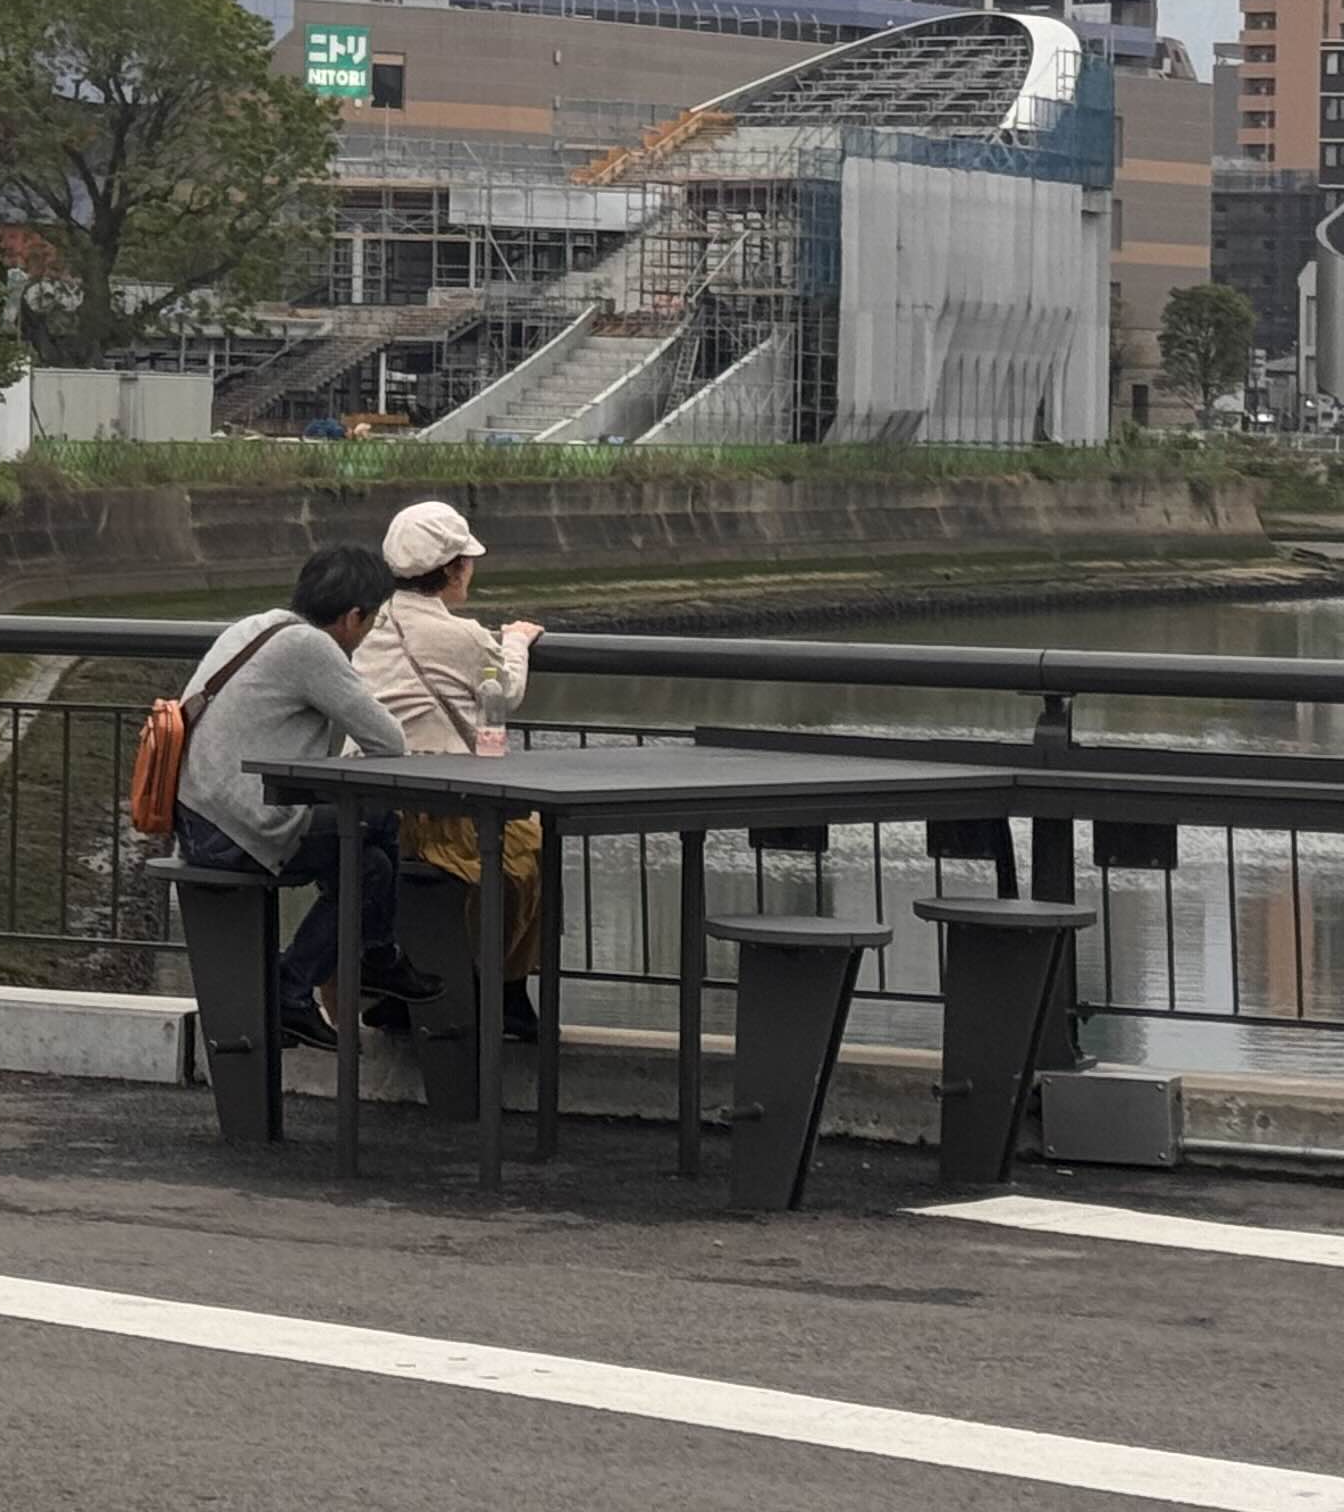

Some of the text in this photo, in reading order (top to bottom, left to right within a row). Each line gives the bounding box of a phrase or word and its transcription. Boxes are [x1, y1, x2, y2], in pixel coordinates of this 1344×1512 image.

[308, 32, 367, 64] ニトリ
[308, 68, 367, 86] NITORI
